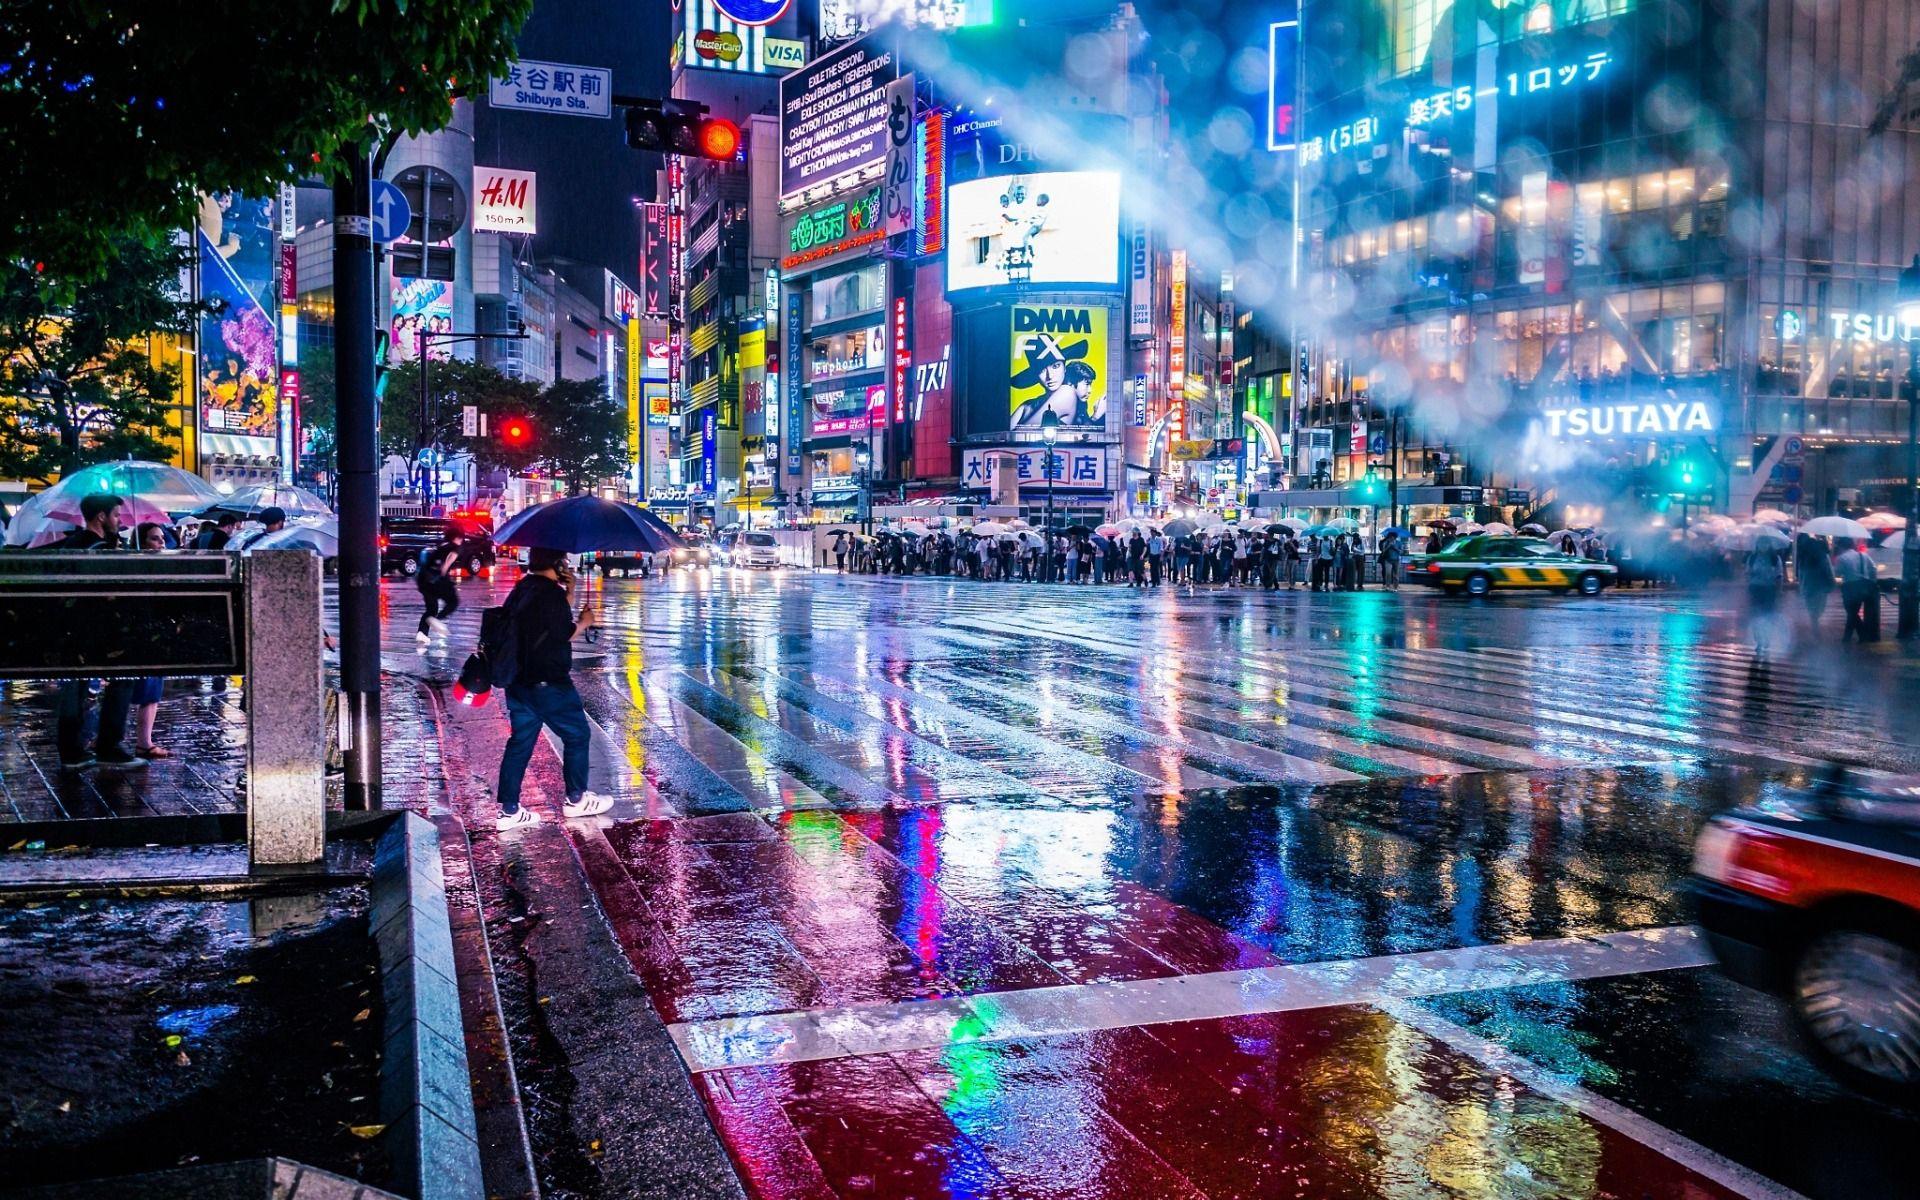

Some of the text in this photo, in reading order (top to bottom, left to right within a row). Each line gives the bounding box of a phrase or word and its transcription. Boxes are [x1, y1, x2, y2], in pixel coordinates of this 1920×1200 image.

[695, 39, 742, 53] MasterCard
[768, 45, 804, 62] VISA
[500, 66, 601, 96] 渋谷駅前
[808, 50, 865, 89] EXILE THE SECOND
[844, 52, 891, 84] GENERATIONS
[515, 91, 590, 110] Shibuya Sta.
[823, 101, 860, 124] DOBERMAN
[953, 116, 1003, 135] DHC Channel
[480, 176, 529, 211] H&M
[485, 214, 514, 225] 150m
[659, 206, 667, 238] TOKYO
[814, 213, 846, 245] 西村
[1014, 307, 1092, 334] DMM
[1013, 334, 1066, 360] FX
[789, 316, 800, 408] サマーフルーツギフト
[815, 357, 865, 376] Euphoria
[652, 399, 669, 413] 薬
[1545, 402, 1713, 436] TSUTAYA
[705, 415, 714, 441] MIZUHO
